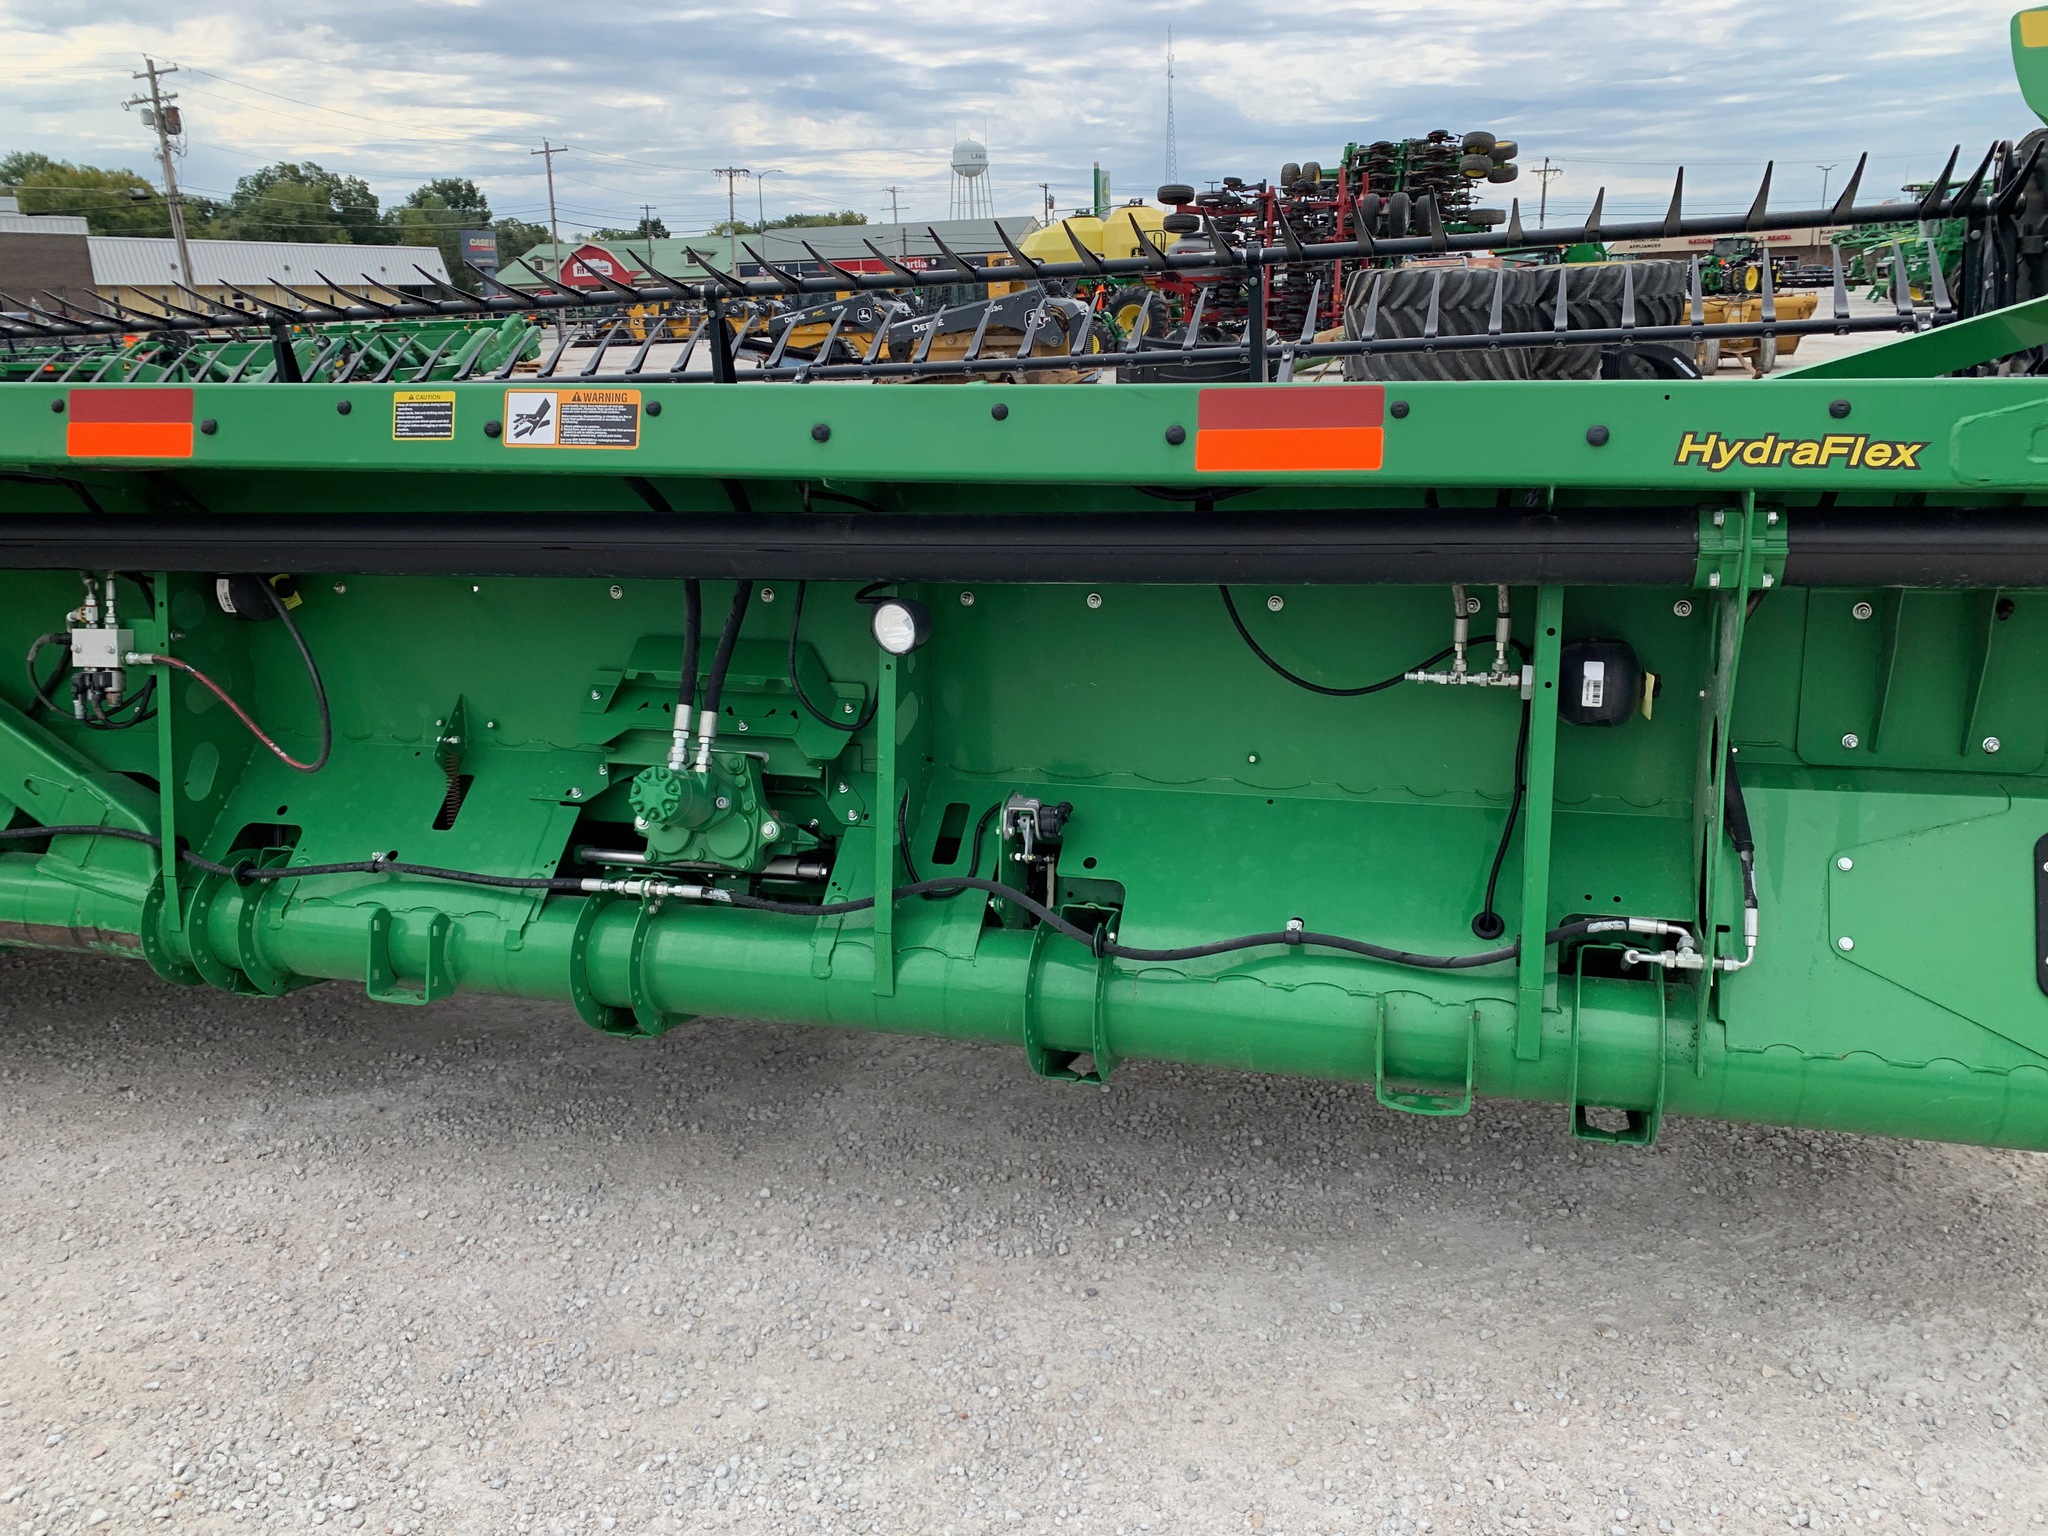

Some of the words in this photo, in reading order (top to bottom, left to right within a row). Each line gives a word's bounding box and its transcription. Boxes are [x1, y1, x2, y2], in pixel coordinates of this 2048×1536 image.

[469, 238, 489, 246] CASE
[912, 318, 945, 333] DEEE
[583, 392, 628, 403] WARNING
[1675, 432, 1926, 471] HydraFlex
